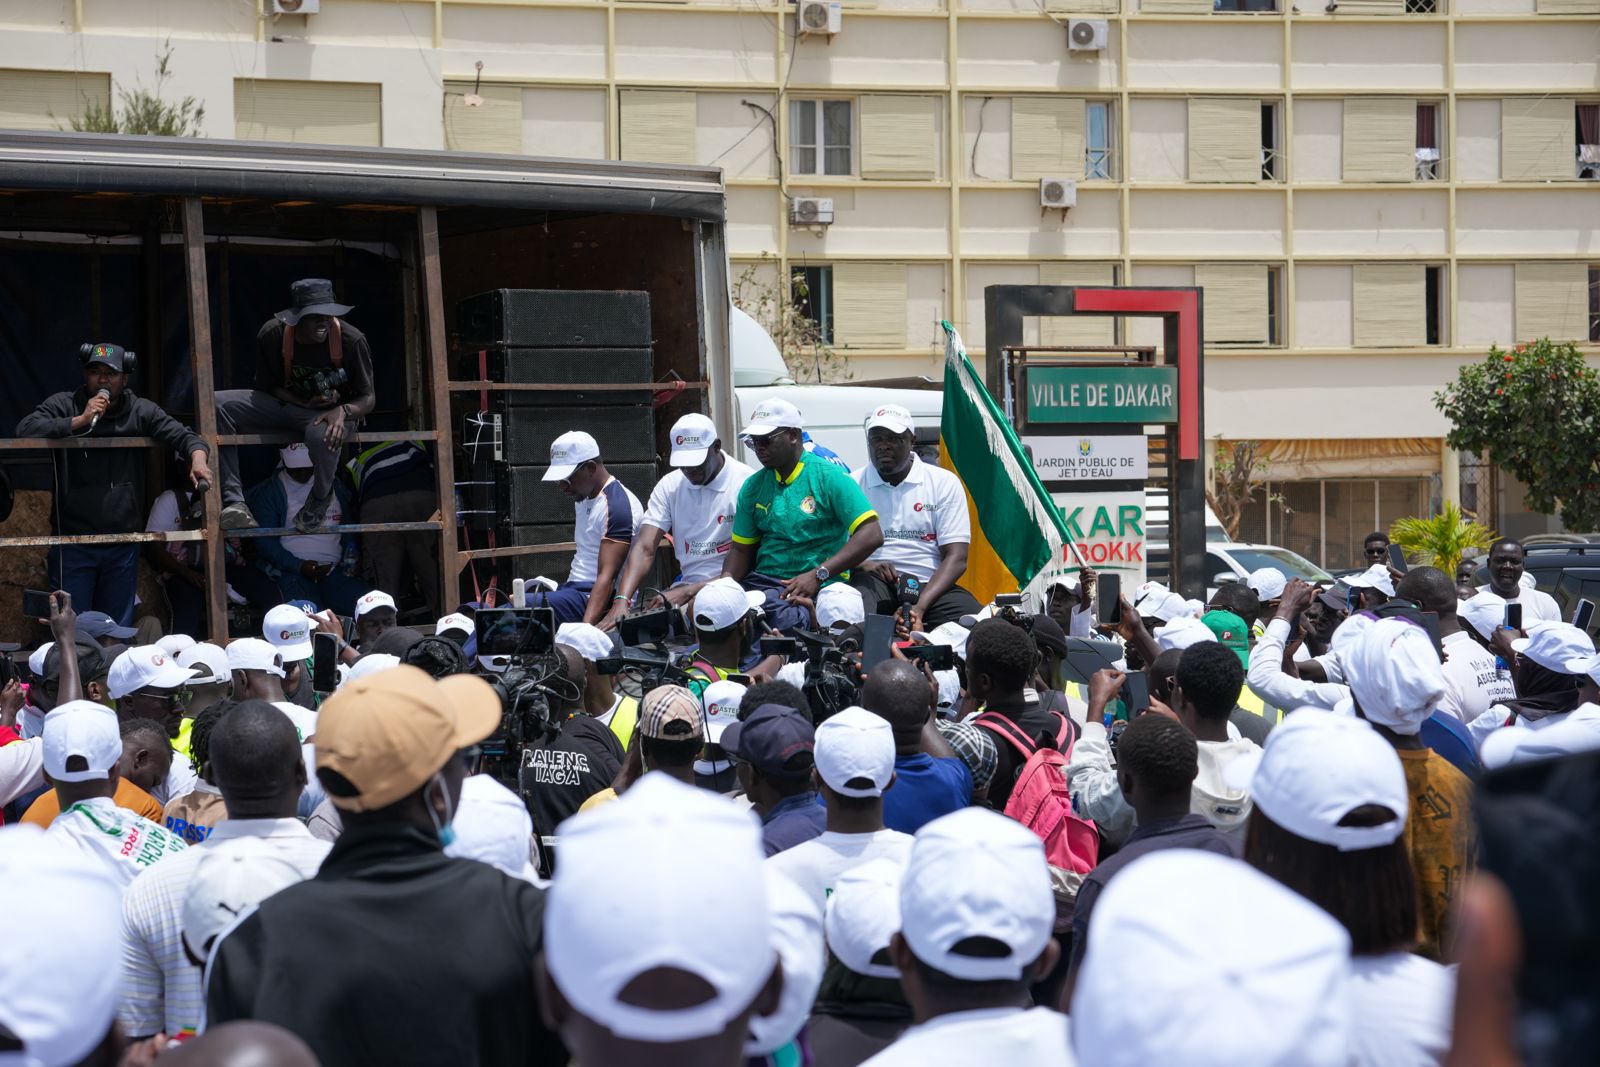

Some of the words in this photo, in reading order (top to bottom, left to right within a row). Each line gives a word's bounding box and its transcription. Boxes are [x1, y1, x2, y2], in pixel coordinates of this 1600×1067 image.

[1032, 384, 1080, 407] VILLE
[1086, 384, 1108, 407] DE
[1114, 384, 1173, 407] DAKAR
[1036, 458, 1076, 468] JARDIN
[1079, 458, 1117, 467] PUBLIC
[1120, 457, 1135, 467] DE
[1058, 468, 1078, 478] JET
[1081, 468, 1113, 478] D'EAU
[1060, 505, 1144, 538] KAR
